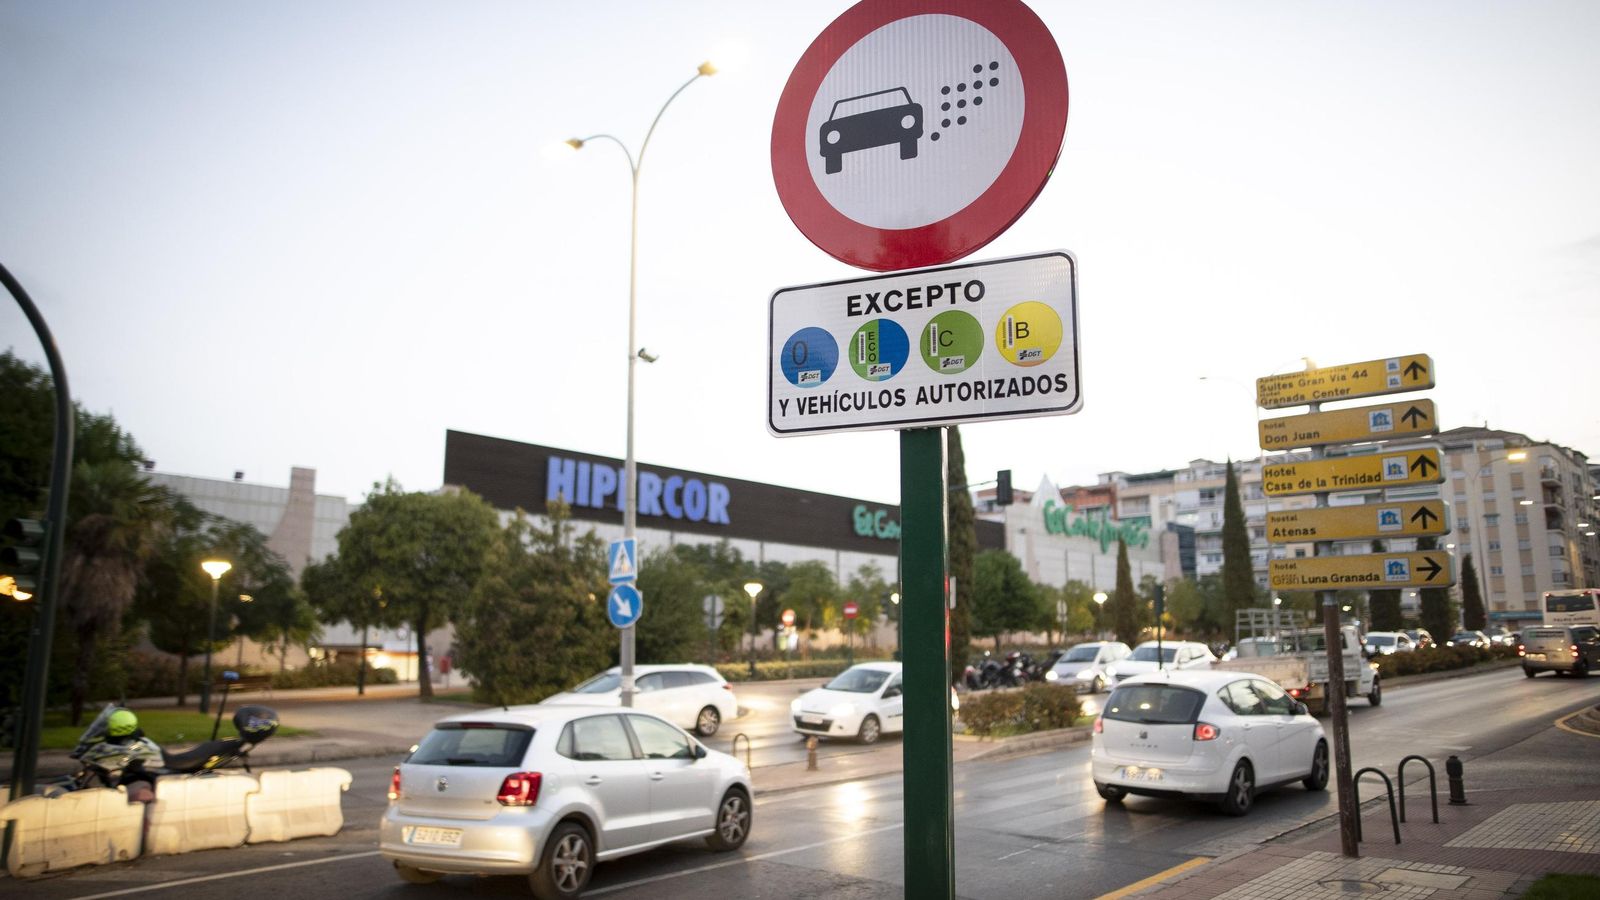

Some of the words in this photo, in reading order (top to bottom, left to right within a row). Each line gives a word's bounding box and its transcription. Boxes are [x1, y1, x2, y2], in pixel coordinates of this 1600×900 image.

[847, 279, 986, 318] EXCEPTO
[1015, 321, 1030, 340] B
[939, 329, 954, 347] C
[1027, 350, 1042, 358] DGT
[950, 358, 964, 366] DGT
[877, 365, 890, 373] DGT
[1260, 380, 1294, 392] Suites
[1298, 376, 1325, 388] Gran
[1352, 369, 1368, 379] 44
[778, 398, 790, 417] Y
[797, 387, 907, 416] VEHÍCULOS
[915, 373, 1069, 406] AUTORIZADOS
[1260, 393, 1306, 406] Granada
[1312, 386, 1351, 399] Center
[1264, 421, 1286, 430] hotel
[1264, 433, 1288, 444] Don
[1293, 430, 1320, 442] Juan
[1264, 466, 1296, 478] Hotel
[1265, 481, 1293, 492] Casa
[1298, 479, 1312, 489] de
[1316, 477, 1327, 487] la
[1332, 471, 1382, 487] Trinidad
[1270, 514, 1298, 523] hostal
[1272, 526, 1317, 538] Atenas
[1274, 562, 1297, 571] hotel
[1301, 574, 1328, 585] Luna
[1330, 572, 1380, 584] Granada
